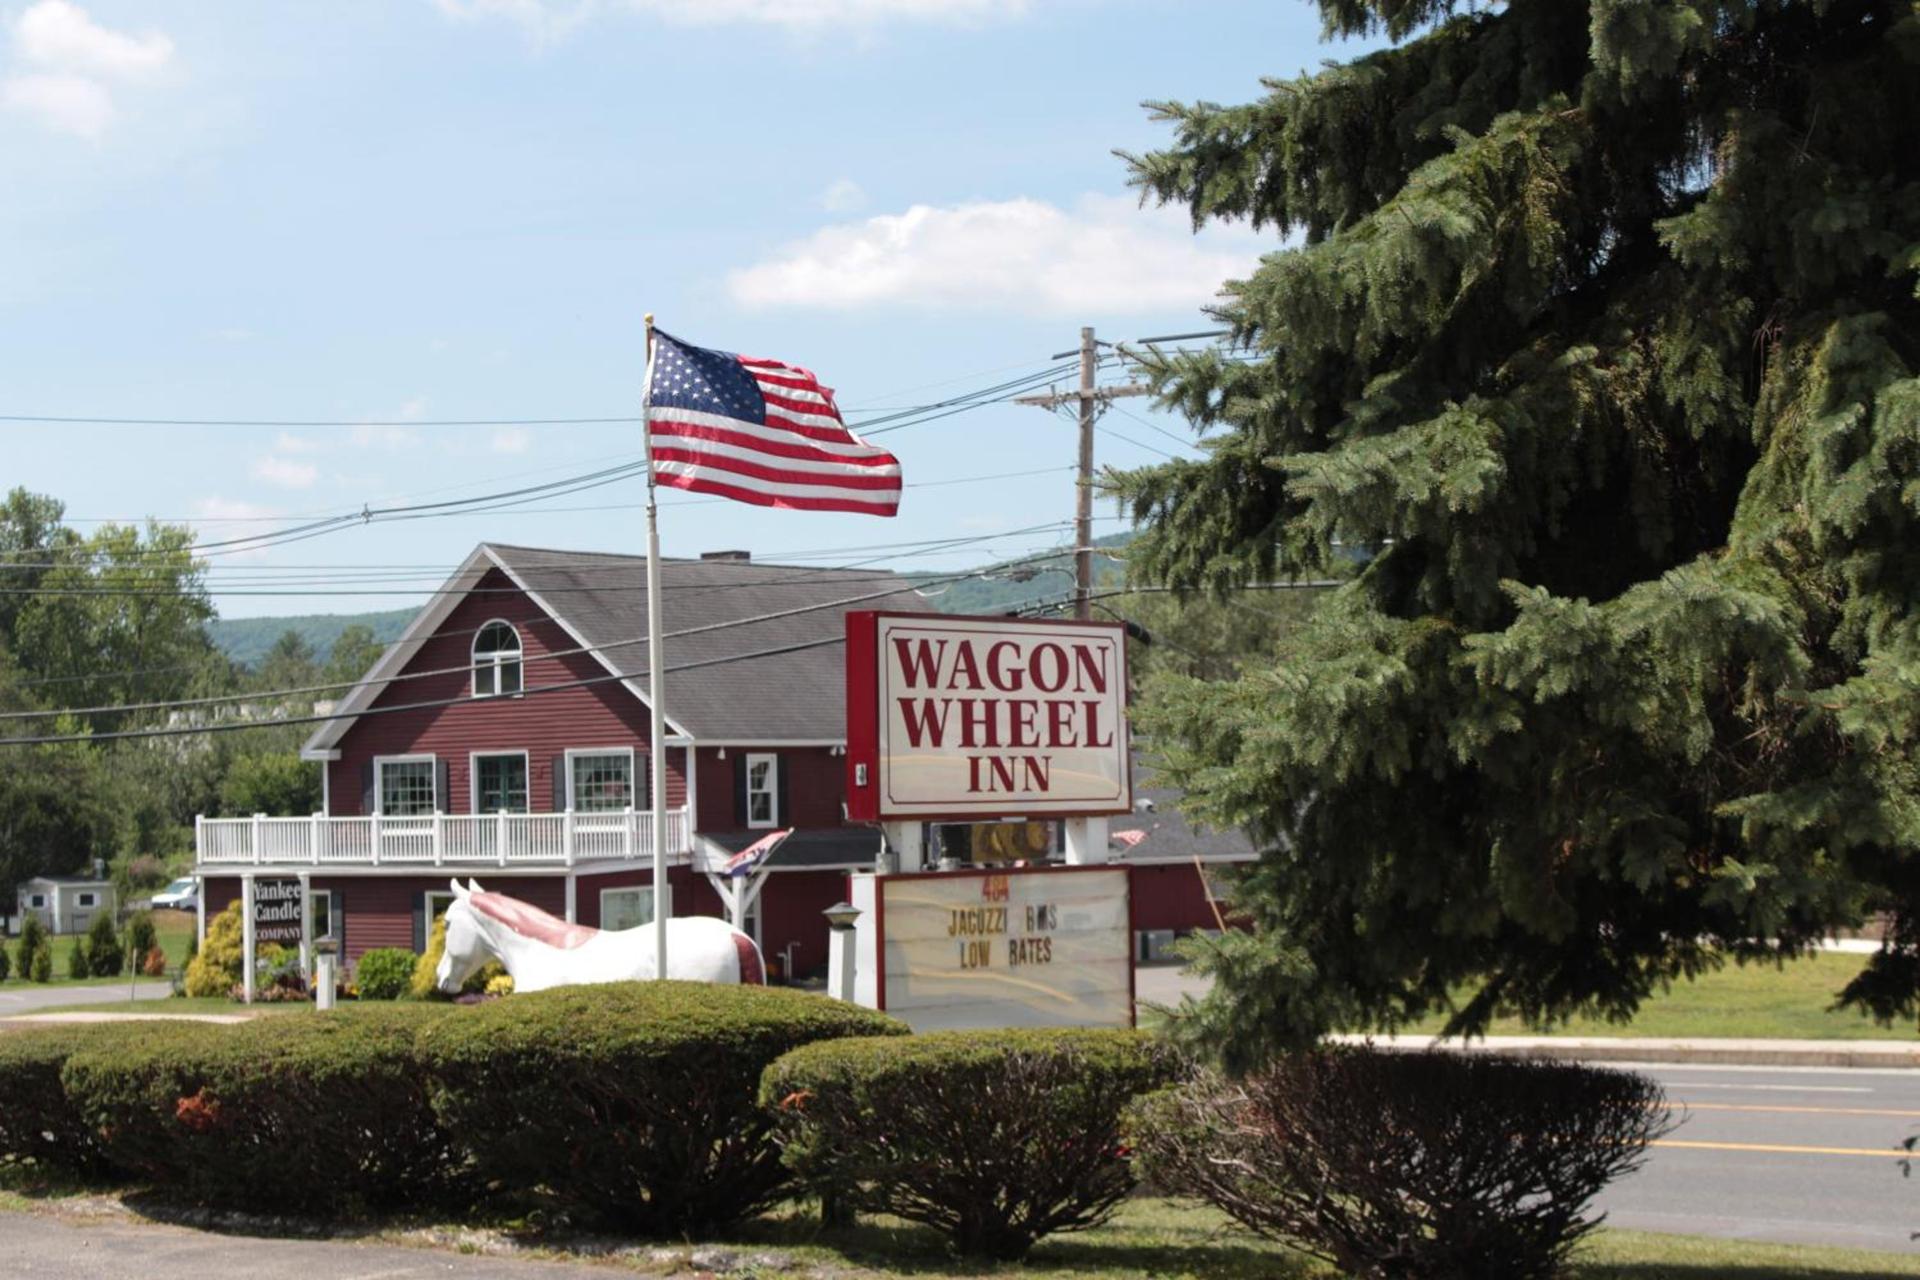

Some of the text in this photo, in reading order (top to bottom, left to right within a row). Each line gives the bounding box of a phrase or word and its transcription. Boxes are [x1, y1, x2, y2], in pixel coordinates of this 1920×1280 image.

[892, 637, 1110, 694] WAGON
[897, 697, 1114, 749] WHEEL
[967, 755, 1052, 793] INN
[254, 880, 301, 900] Yankee
[255, 901, 301, 921] Candle
[948, 907, 1008, 936] JACUZZI
[255, 927, 301, 941] COMPANY
[960, 937, 1052, 969] LOW RATES
